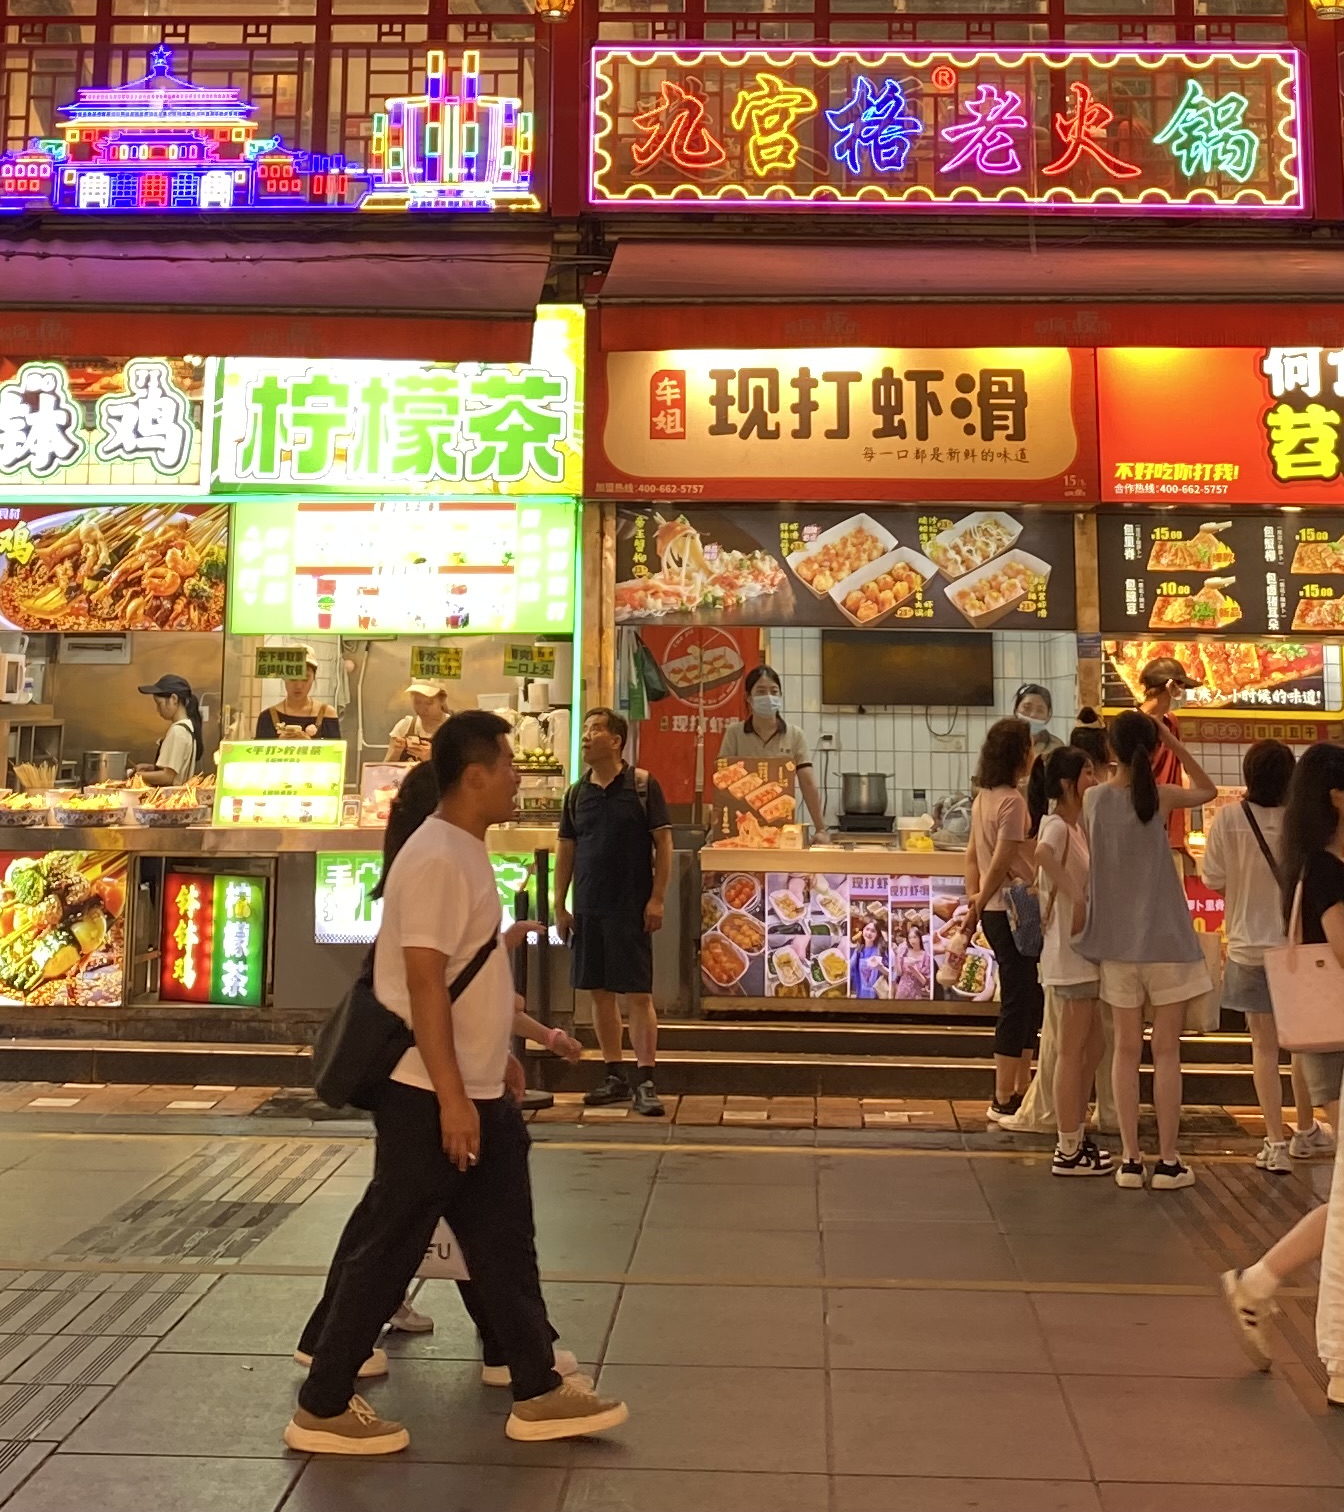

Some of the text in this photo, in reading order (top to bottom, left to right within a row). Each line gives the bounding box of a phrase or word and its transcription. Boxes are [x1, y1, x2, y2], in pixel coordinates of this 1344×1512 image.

[632, 73, 1259, 183] 九宫格老火锅
[241, 373, 563, 475] 柠檬茶
[652, 377, 686, 435] 车姐
[708, 366, 1029, 442] 现打虾滑
[862, 445, 1031, 464] 每一口都是新鲜的味道
[1114, 462, 1240, 482] 不好吃你打我!
[506, 662, 552, 676] 一口上头
[172, 883, 201, 990] 钵钵鸡
[220, 880, 251, 999] 柠檬茶
